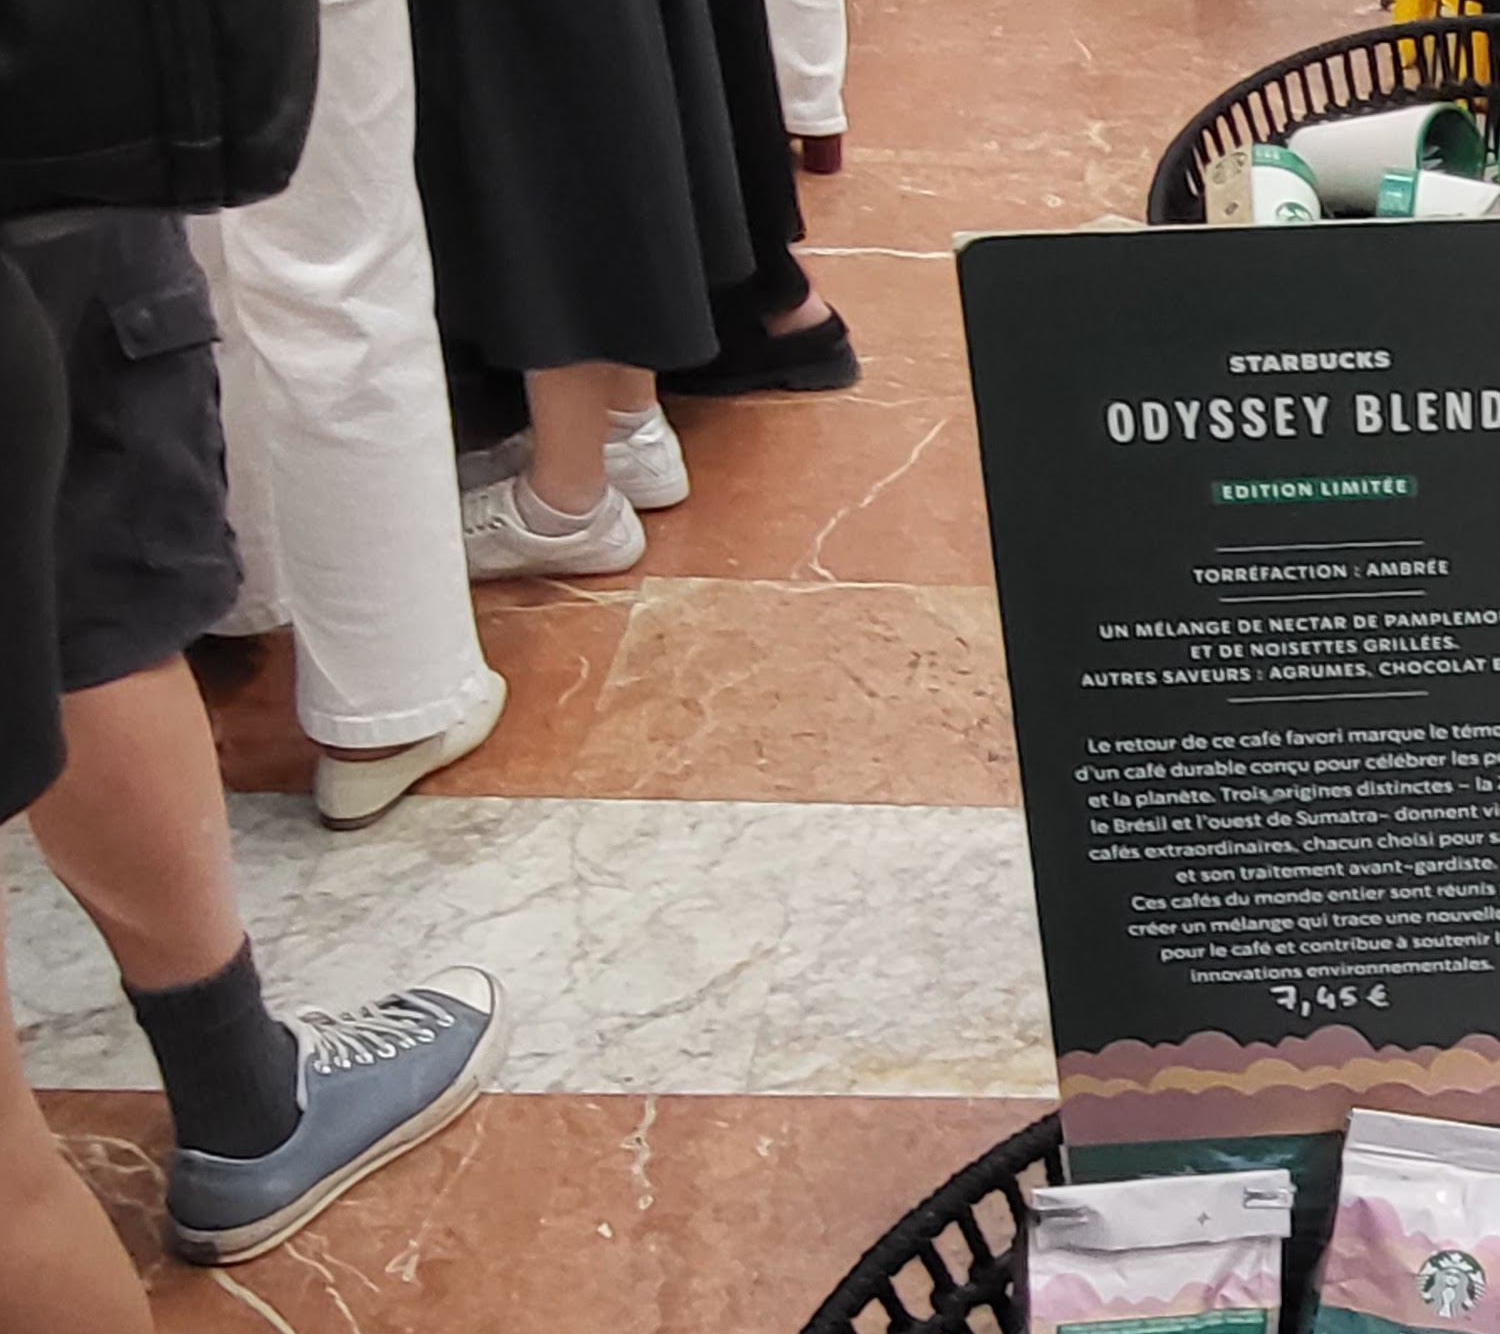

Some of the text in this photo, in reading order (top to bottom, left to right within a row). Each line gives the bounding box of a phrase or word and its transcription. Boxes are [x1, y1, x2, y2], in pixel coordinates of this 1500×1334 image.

[1229, 350, 1392, 374] STARBUCKS
[1106, 394, 1330, 444] ODYSSEY
[1221, 475, 1409, 501] EDITION LIMITÉE
[1193, 563, 1348, 584] TORRÉFACTION
[1366, 558, 1449, 577] AMBRÉE
[1099, 623, 1130, 639] UN
[1135, 618, 1232, 638] MÉLANGE
[1237, 618, 1263, 634] DE
[1269, 615, 1347, 633] NECTAR
[1353, 614, 1379, 629] DE
[1190, 633, 1461, 660] ET DE NOISETTES GRILLÉES.
[1081, 670, 1158, 687] AUTRES
[1162, 667, 1251, 684] SAVEURS
[1379, 657, 1487, 675] CHOCOLAT
[1088, 738, 1111, 754] Le
[1115, 737, 1177, 753] retour
[1181, 734, 1208, 750] de
[1212, 735, 1236, 749] ce
[1239, 730, 1282, 747] café
[1286, 728, 1343, 746] favori
[1348, 728, 1426, 747] marque
[1430, 724, 1448, 740] le
[1074, 765, 1120, 782] d'un
[1124, 763, 1167, 780] café
[1170, 760, 1247, 778] durable
[1250, 760, 1309, 777] conçu
[1314, 758, 1361, 774] pour
[1365, 753, 1447, 770] célébrer
[1451, 750, 1479, 766] les
[1088, 794, 1110, 809] et
[1113, 791, 1132, 807] la
[1220, 785, 1268, 803] Trois
[1272, 782, 1352, 803] origines
[1356, 779, 1454, 798] distinctes
[1475, 776, 1493, 791] la
[1090, 818, 1109, 834] le
[1113, 816, 1168, 834] Brésil
[1171, 816, 1193, 831] et
[1196, 813, 1263, 830] l'ouest
[1266, 811, 1292, 827] de
[1394, 804, 1478, 822] donnent
[1088, 844, 1141, 861] cafés
[1302, 834, 1373, 853] chacun
[1377, 831, 1434, 848] choisi
[1438, 831, 1484, 848] pour
[1175, 869, 1197, 884] et
[1200, 869, 1236, 883] son
[1240, 862, 1345, 881] traitement
[1131, 895, 1167, 911] Ces
[1170, 892, 1222, 909] cafés
[1224, 891, 1250, 907] du
[1254, 888, 1324, 906] monde
[1327, 886, 1385, 903] entier
[1390, 884, 1433, 900] sont
[1436, 880, 1496, 898] réunis
[1128, 921, 1178, 937] créer
[1181, 920, 1206, 935] un
[1209, 915, 1295, 933] mélange
[1297, 912, 1328, 931] qui
[1332, 913, 1383, 928] trace
[1385, 912, 1422, 926] une
[1160, 948, 1206, 963] pour
[1209, 942, 1228, 958] le
[1231, 939, 1272, 957] café
[1274, 940, 1296, 955] et
[1299, 936, 1393, 955] contribue
[1396, 935, 1408, 950] à
[1412, 931, 1491, 950] soutenir
[1190, 965, 1303, 983] innovations
[1270, 983, 1391, 1017] 7,45 €
